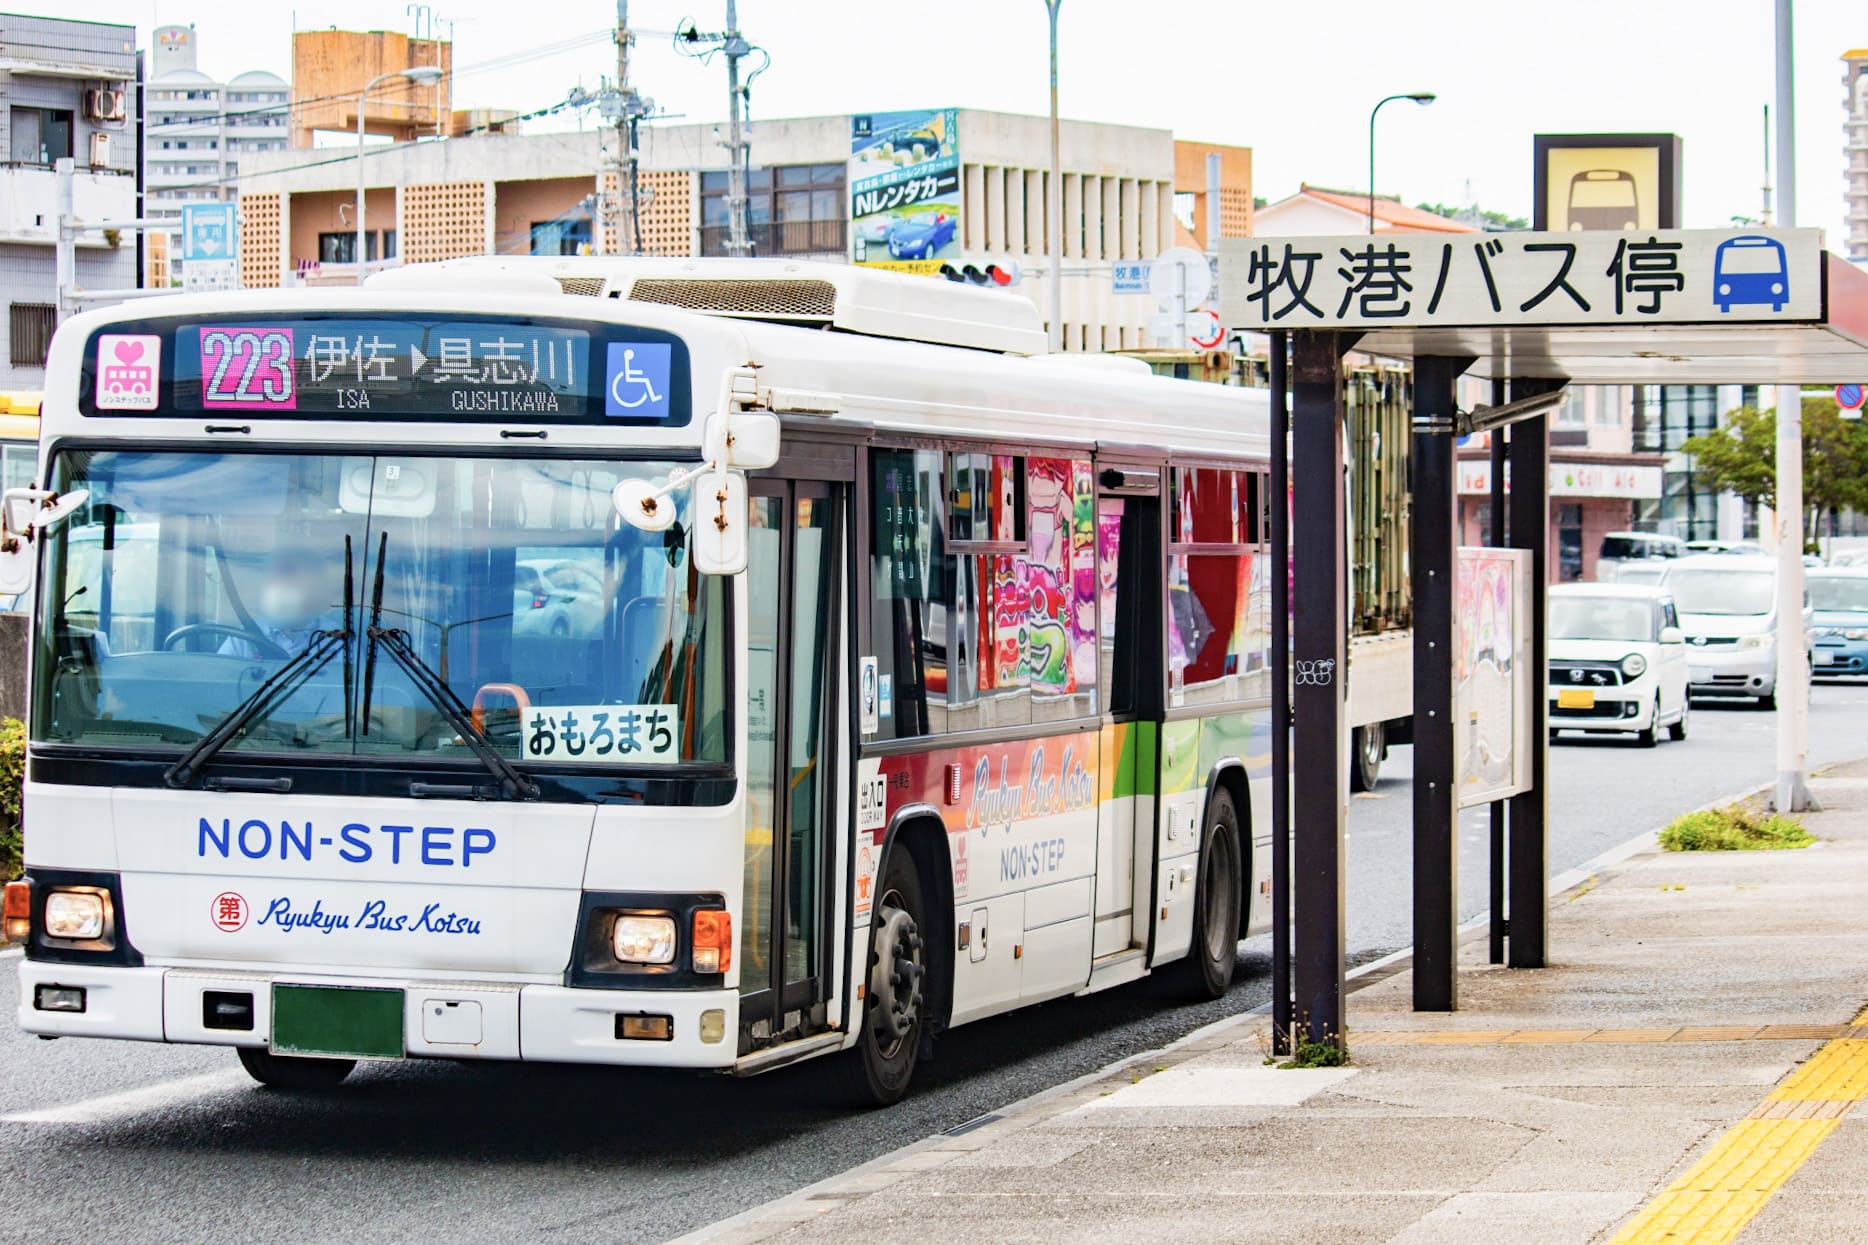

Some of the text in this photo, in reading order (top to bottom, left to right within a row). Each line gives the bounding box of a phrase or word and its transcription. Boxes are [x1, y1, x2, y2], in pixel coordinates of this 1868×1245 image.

[856, 175, 956, 216] Nレンタカー
[1247, 237, 1685, 321] 牧港バス停
[203, 331, 294, 402] 223
[304, 334, 573, 384] 伊佐 具志川
[336, 389, 370, 409] ISA
[452, 391, 559, 411] GUSHIKAWA
[530, 708, 672, 756] おもろまち
[861, 780, 884, 809] 出入口
[966, 742, 1092, 837] Ryukyu Bus Kotsu
[199, 817, 496, 867] NON-STEP
[1000, 838, 1065, 882] NON-STEP
[257, 897, 481, 934] Ryukyu Bus Kotsu
